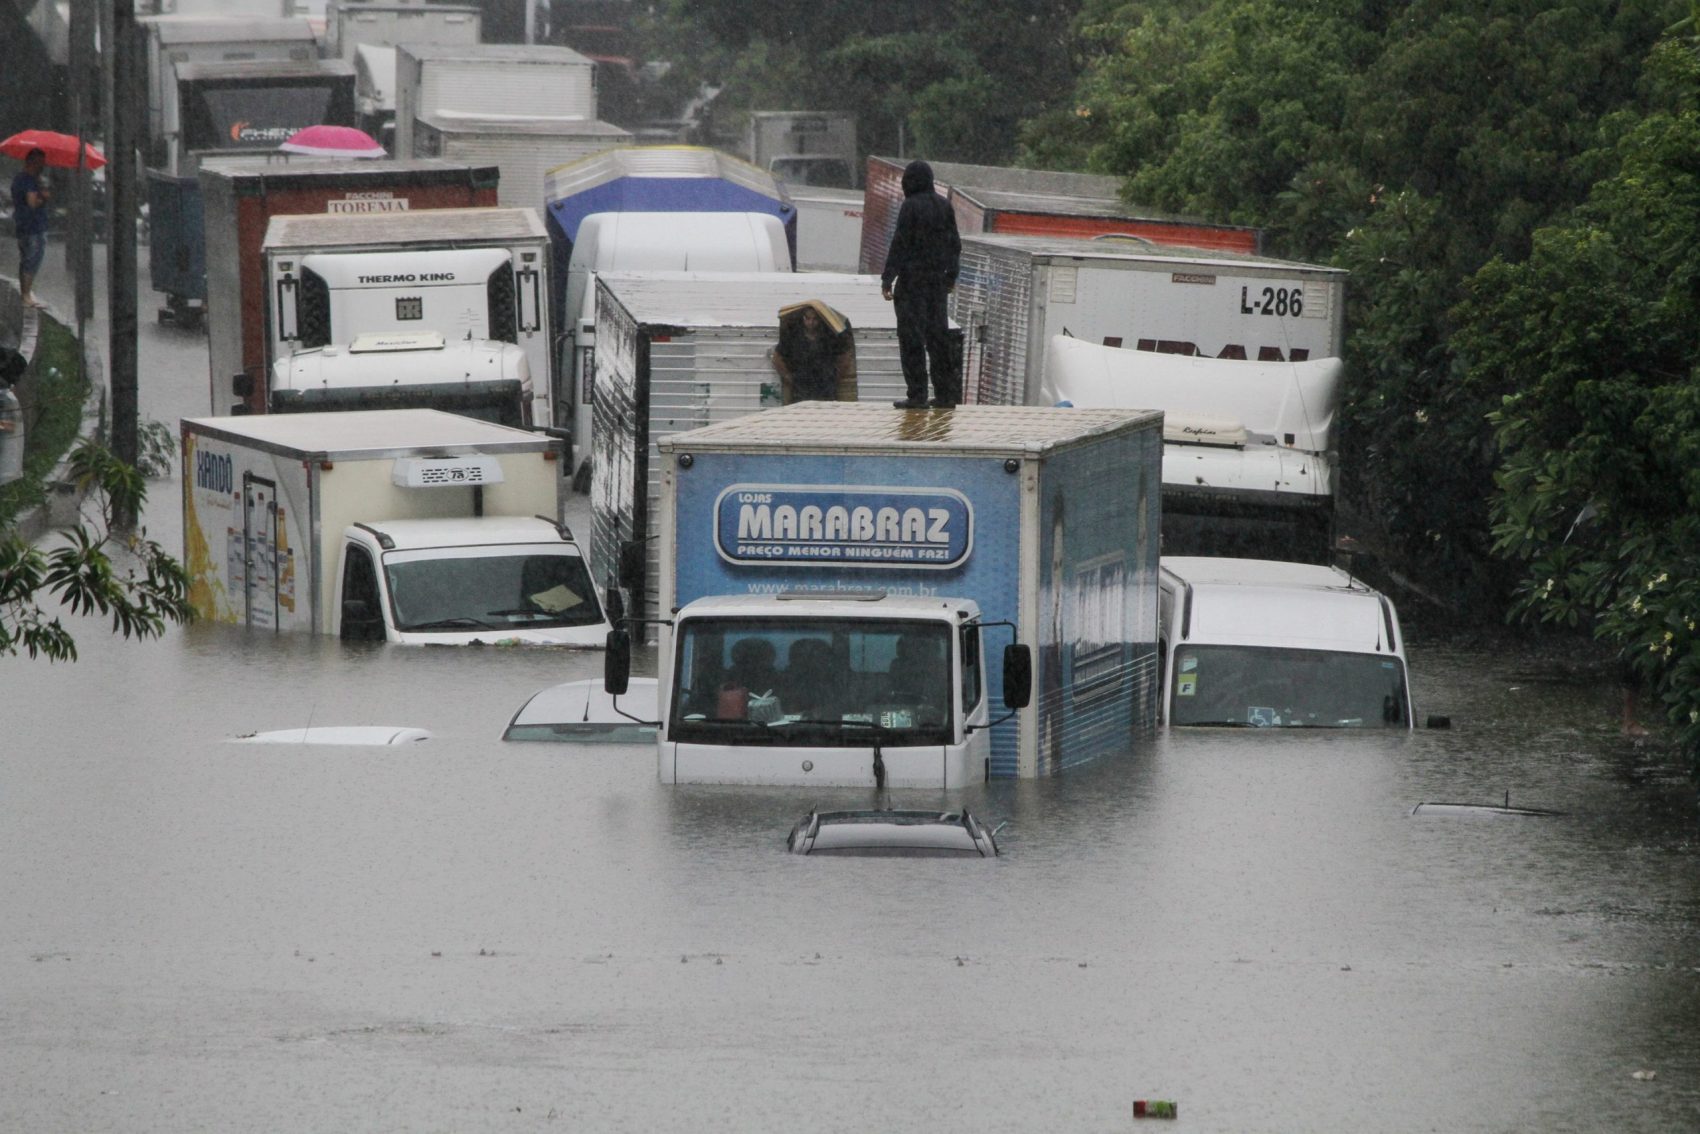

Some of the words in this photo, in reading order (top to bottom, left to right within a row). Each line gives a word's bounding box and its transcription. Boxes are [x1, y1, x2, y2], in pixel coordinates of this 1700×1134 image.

[329, 200, 404, 213] TOREMA
[358, 274, 416, 283] THERMO
[420, 273, 455, 281] KING
[1240, 286, 1302, 317] L-286
[197, 450, 233, 494] XANDÔ
[738, 493, 773, 504] LOJAS
[737, 504, 951, 543] MARABRAZ
[737, 545, 784, 558] PREÇO
[788, 546, 841, 557] MENOR
[844, 545, 914, 558] NINGUÉM
[918, 549, 950, 560] FAZ!
